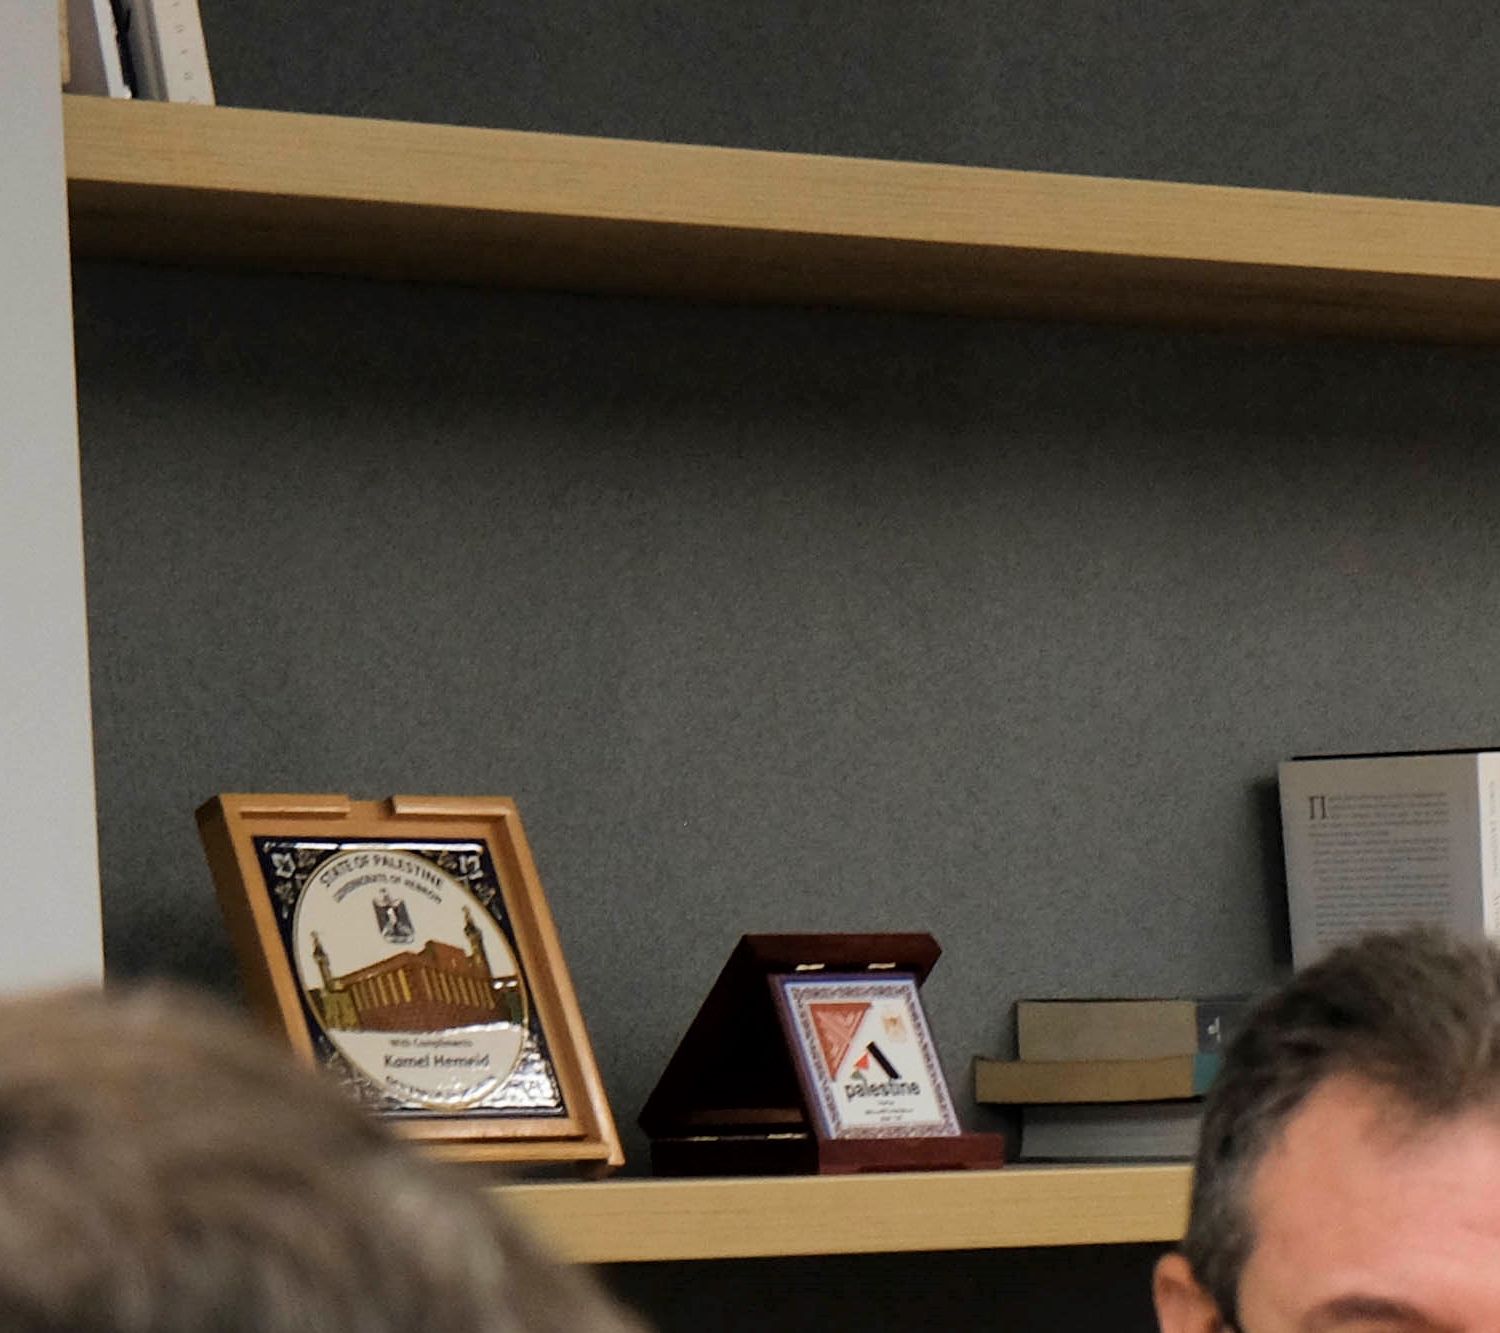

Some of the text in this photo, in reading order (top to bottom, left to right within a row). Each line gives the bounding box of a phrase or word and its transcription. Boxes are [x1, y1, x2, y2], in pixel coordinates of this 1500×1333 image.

[319, 858, 354, 888] STATE
[372, 854, 444, 889] PALESTINE
[384, 1054, 430, 1068] Kamel
